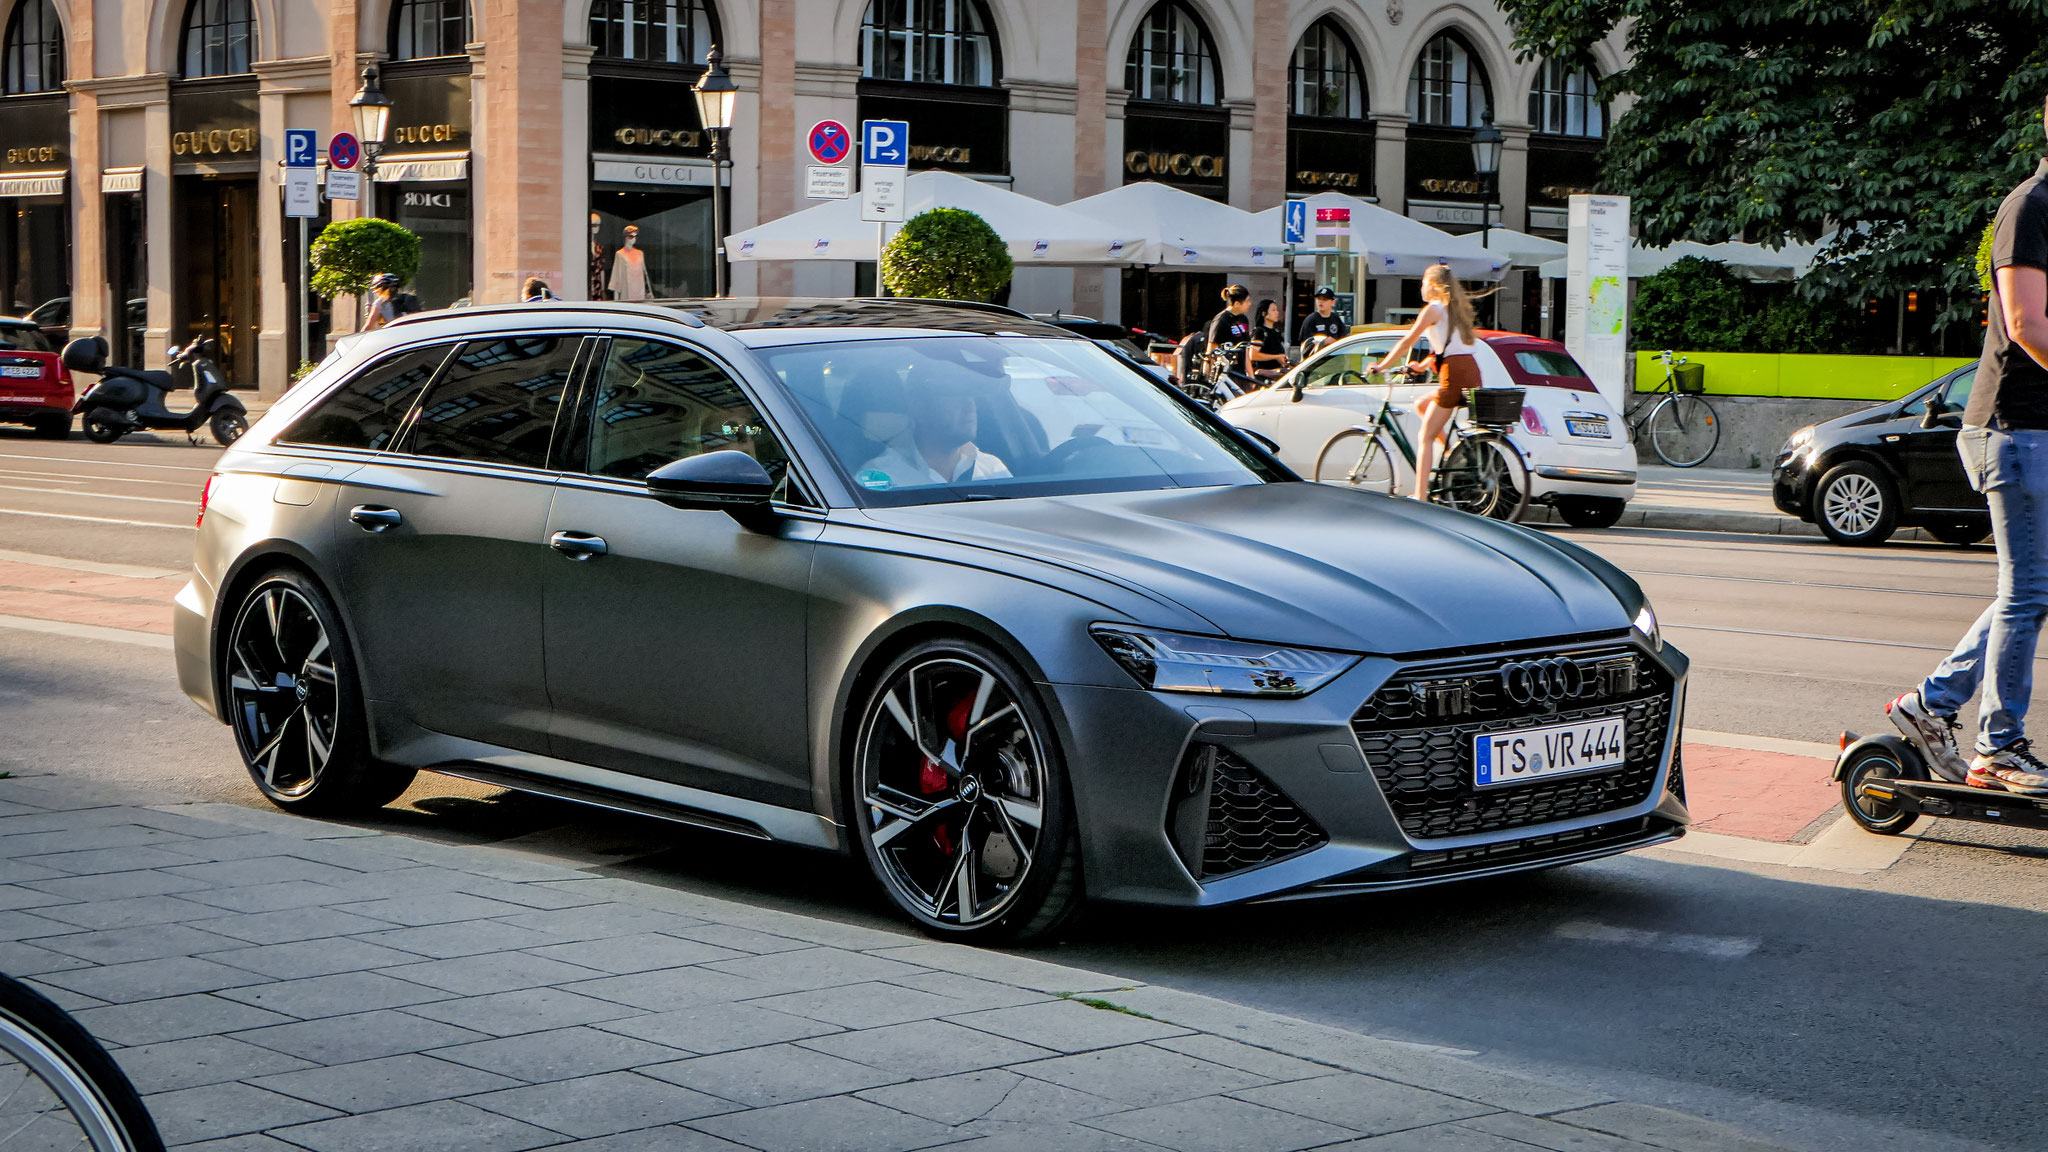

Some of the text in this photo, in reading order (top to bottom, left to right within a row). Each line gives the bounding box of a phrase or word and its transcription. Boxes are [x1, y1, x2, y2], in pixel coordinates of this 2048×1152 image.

[173, 128, 253, 155] GUCCI
[395, 124, 453, 143] GUCCI
[616, 128, 700, 147] GUCCI
[870, 126, 894, 159] P
[7, 146, 55, 163] GUCCI
[289, 134, 308, 163] P
[635, 166, 692, 181] GUCCI
[1126, 150, 1223, 177] GUCCI
[1480, 724, 1621, 776] D TS VR 444
